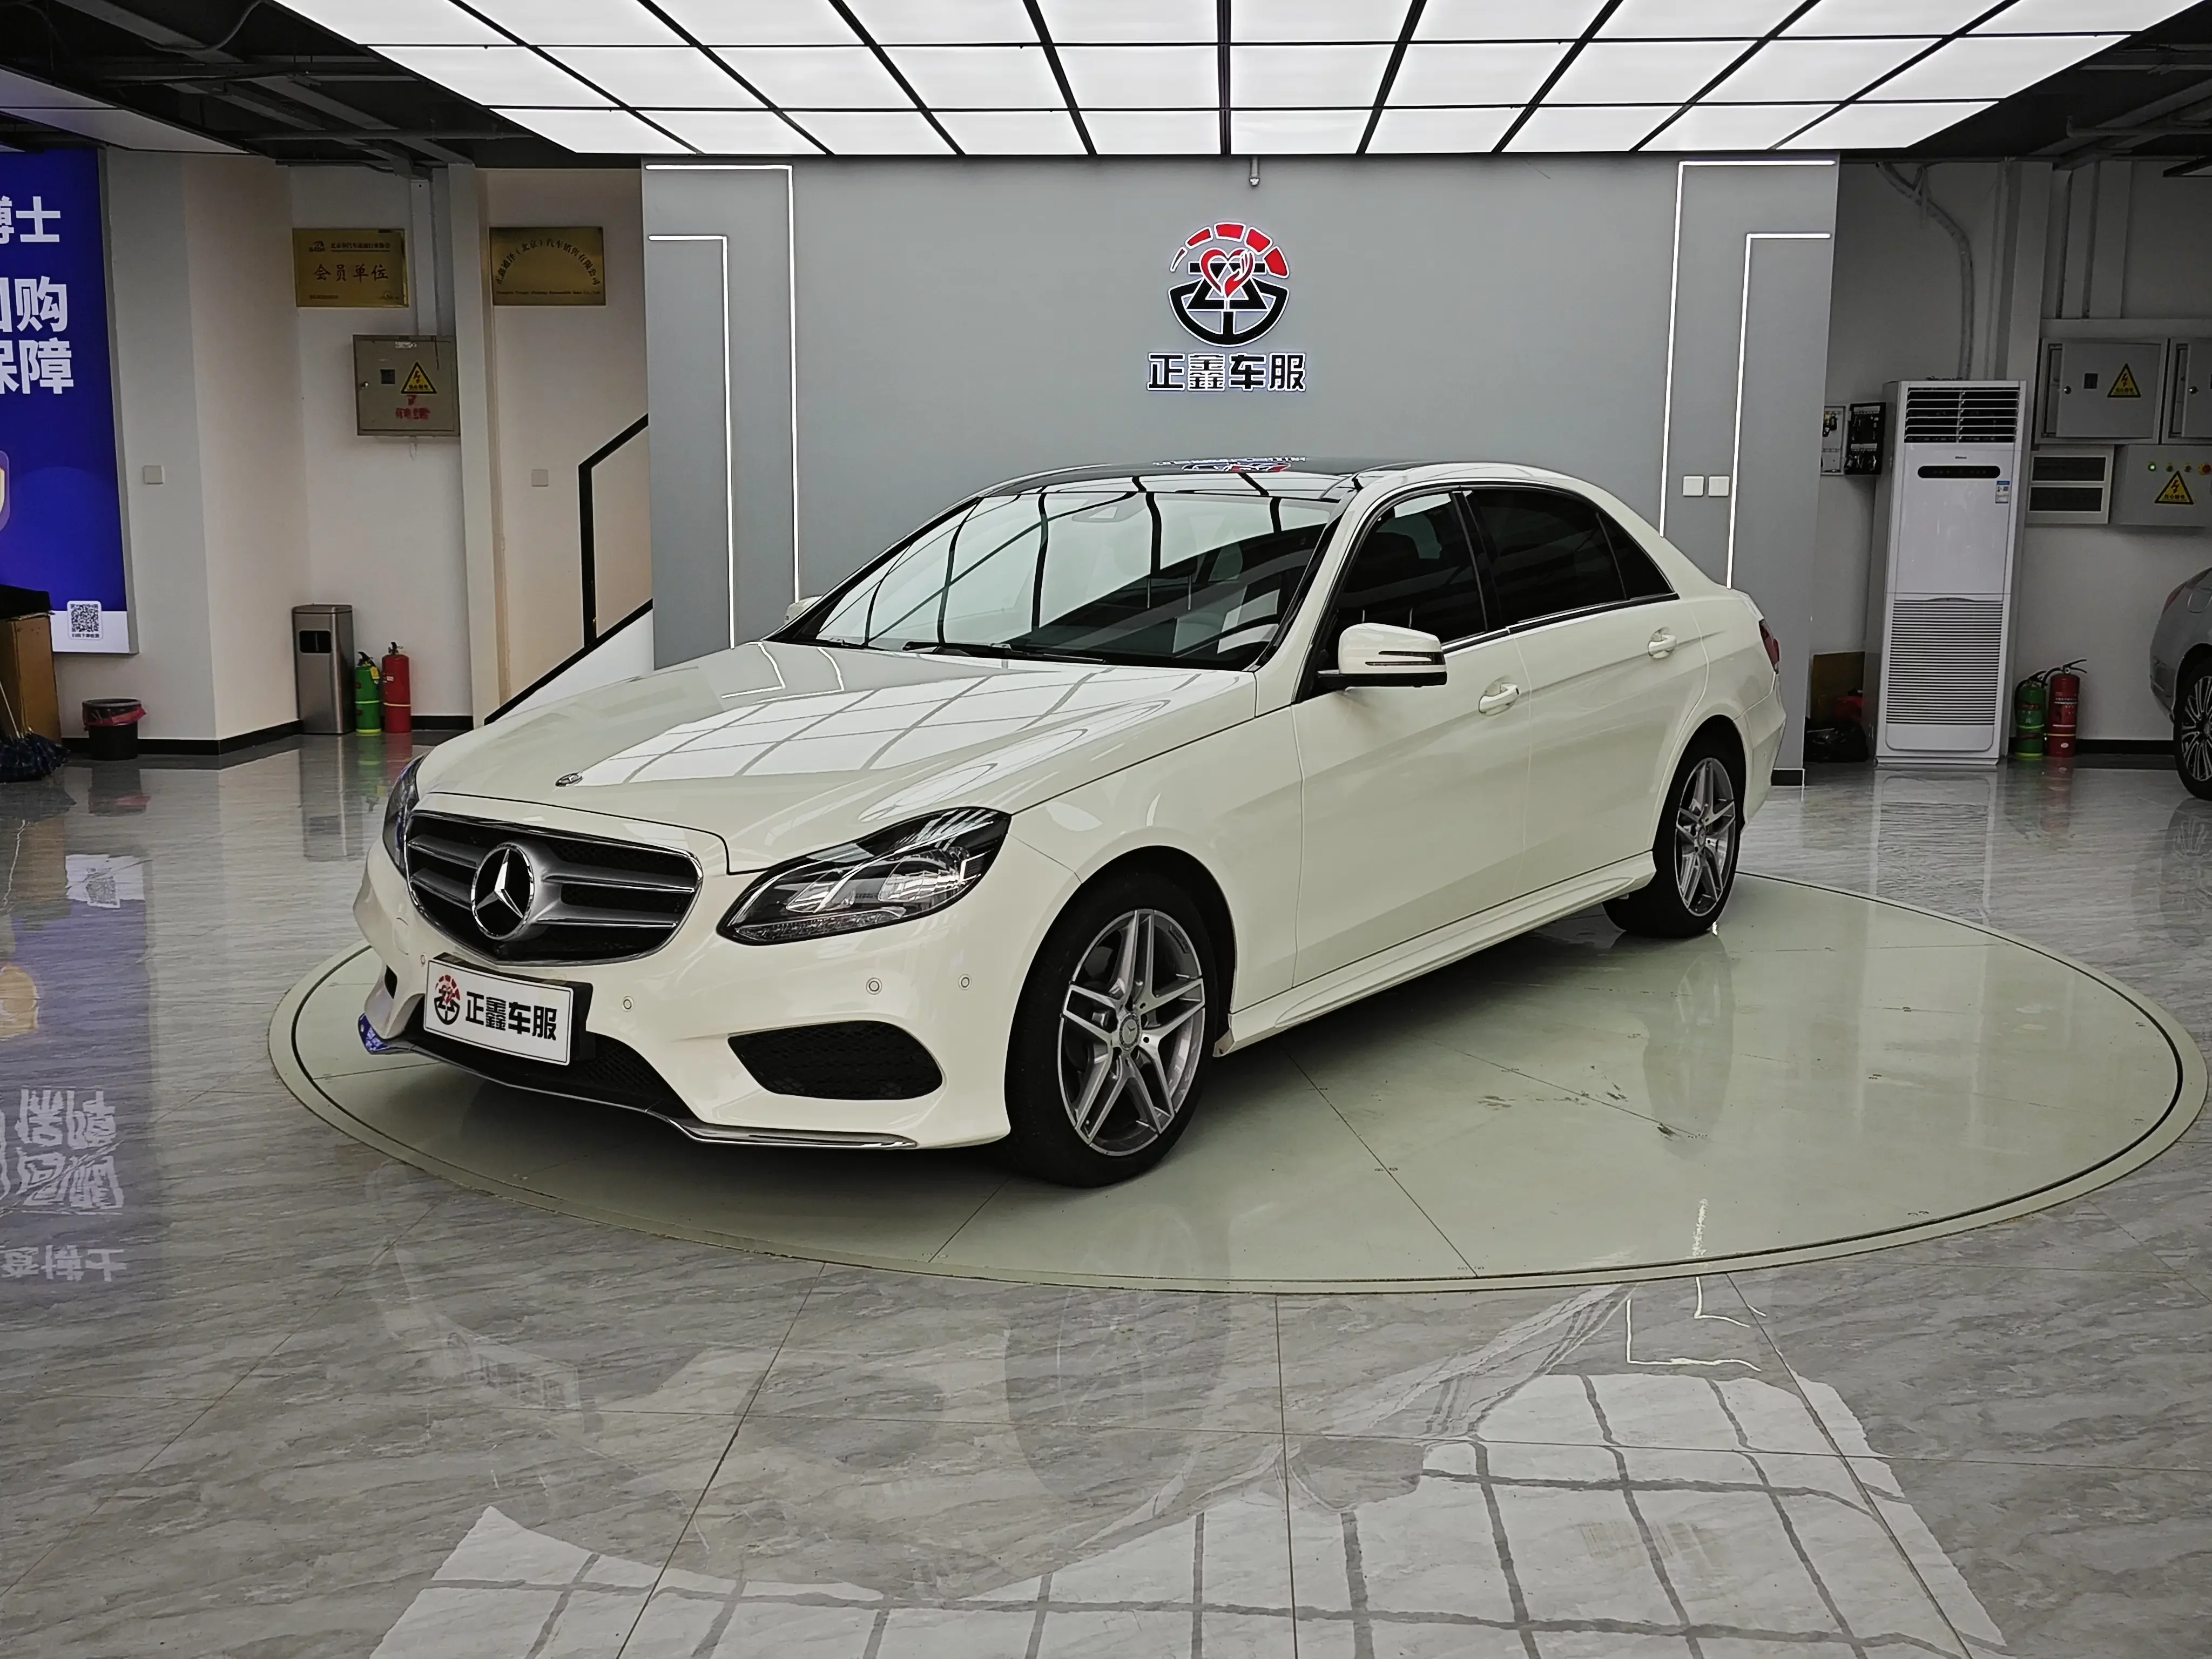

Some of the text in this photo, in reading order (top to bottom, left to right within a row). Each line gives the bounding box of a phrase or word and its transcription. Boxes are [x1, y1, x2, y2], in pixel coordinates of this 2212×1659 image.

[314, 264, 389, 283] 会员单位
[0, 276, 68, 333] 购
[1147, 353, 1306, 392] 正鑫车服
[466, 990, 557, 1041] 正鑫车服
